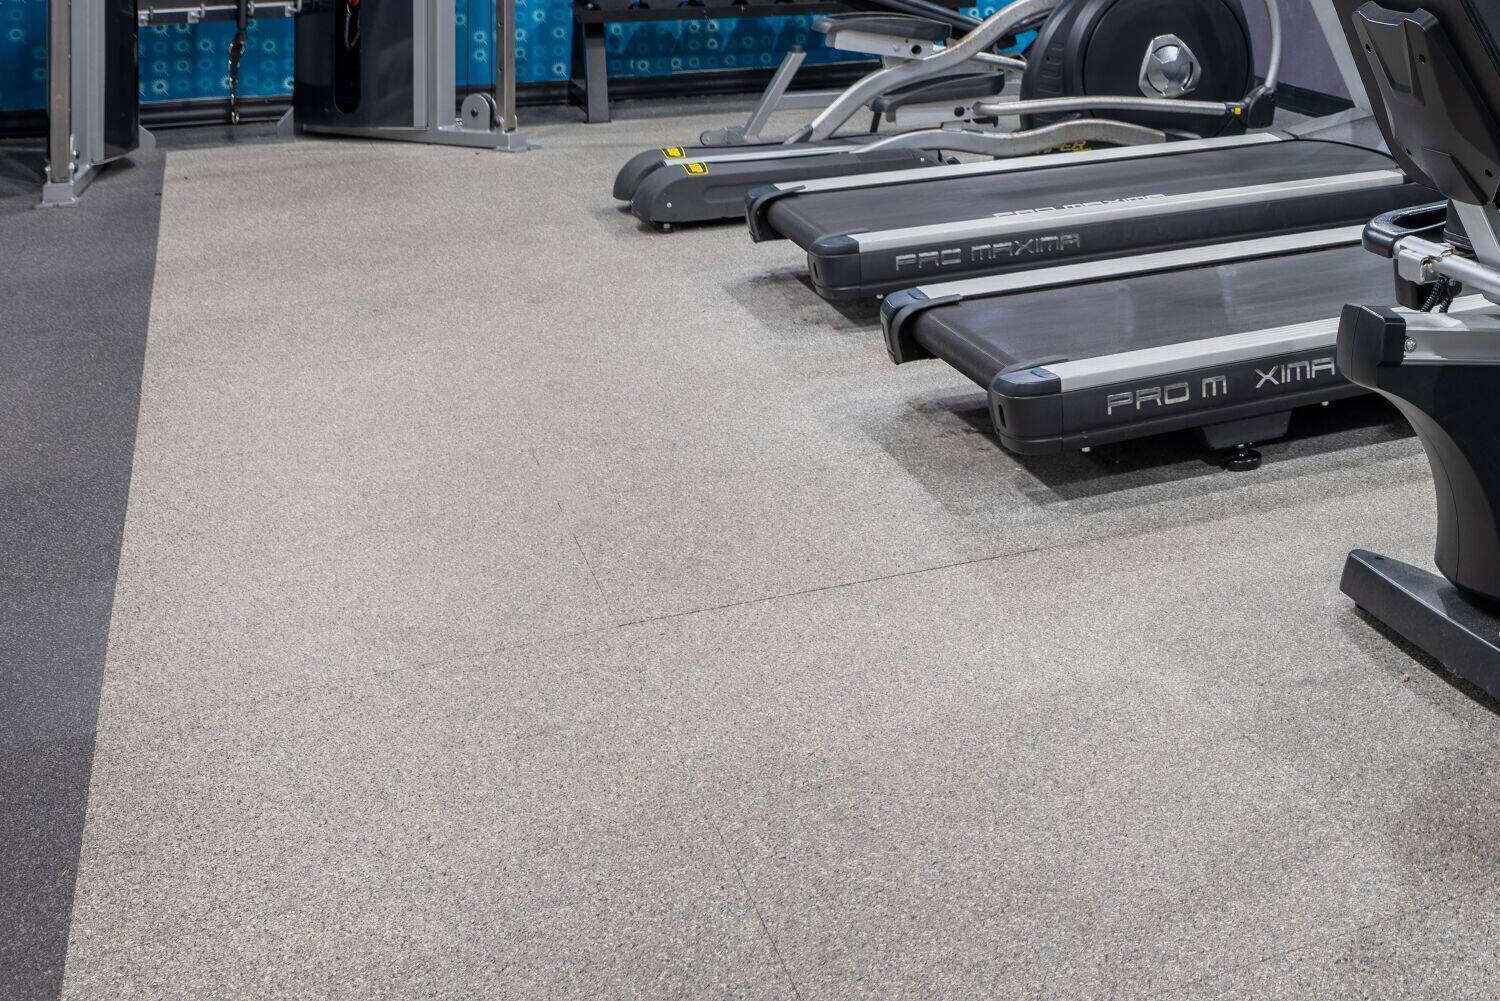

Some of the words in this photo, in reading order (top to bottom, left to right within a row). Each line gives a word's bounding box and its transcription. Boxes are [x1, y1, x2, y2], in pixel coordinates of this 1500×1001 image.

[895, 248, 961, 271] PRO
[971, 232, 1080, 262] MAXIMA
[1107, 381, 1190, 415] PRO
